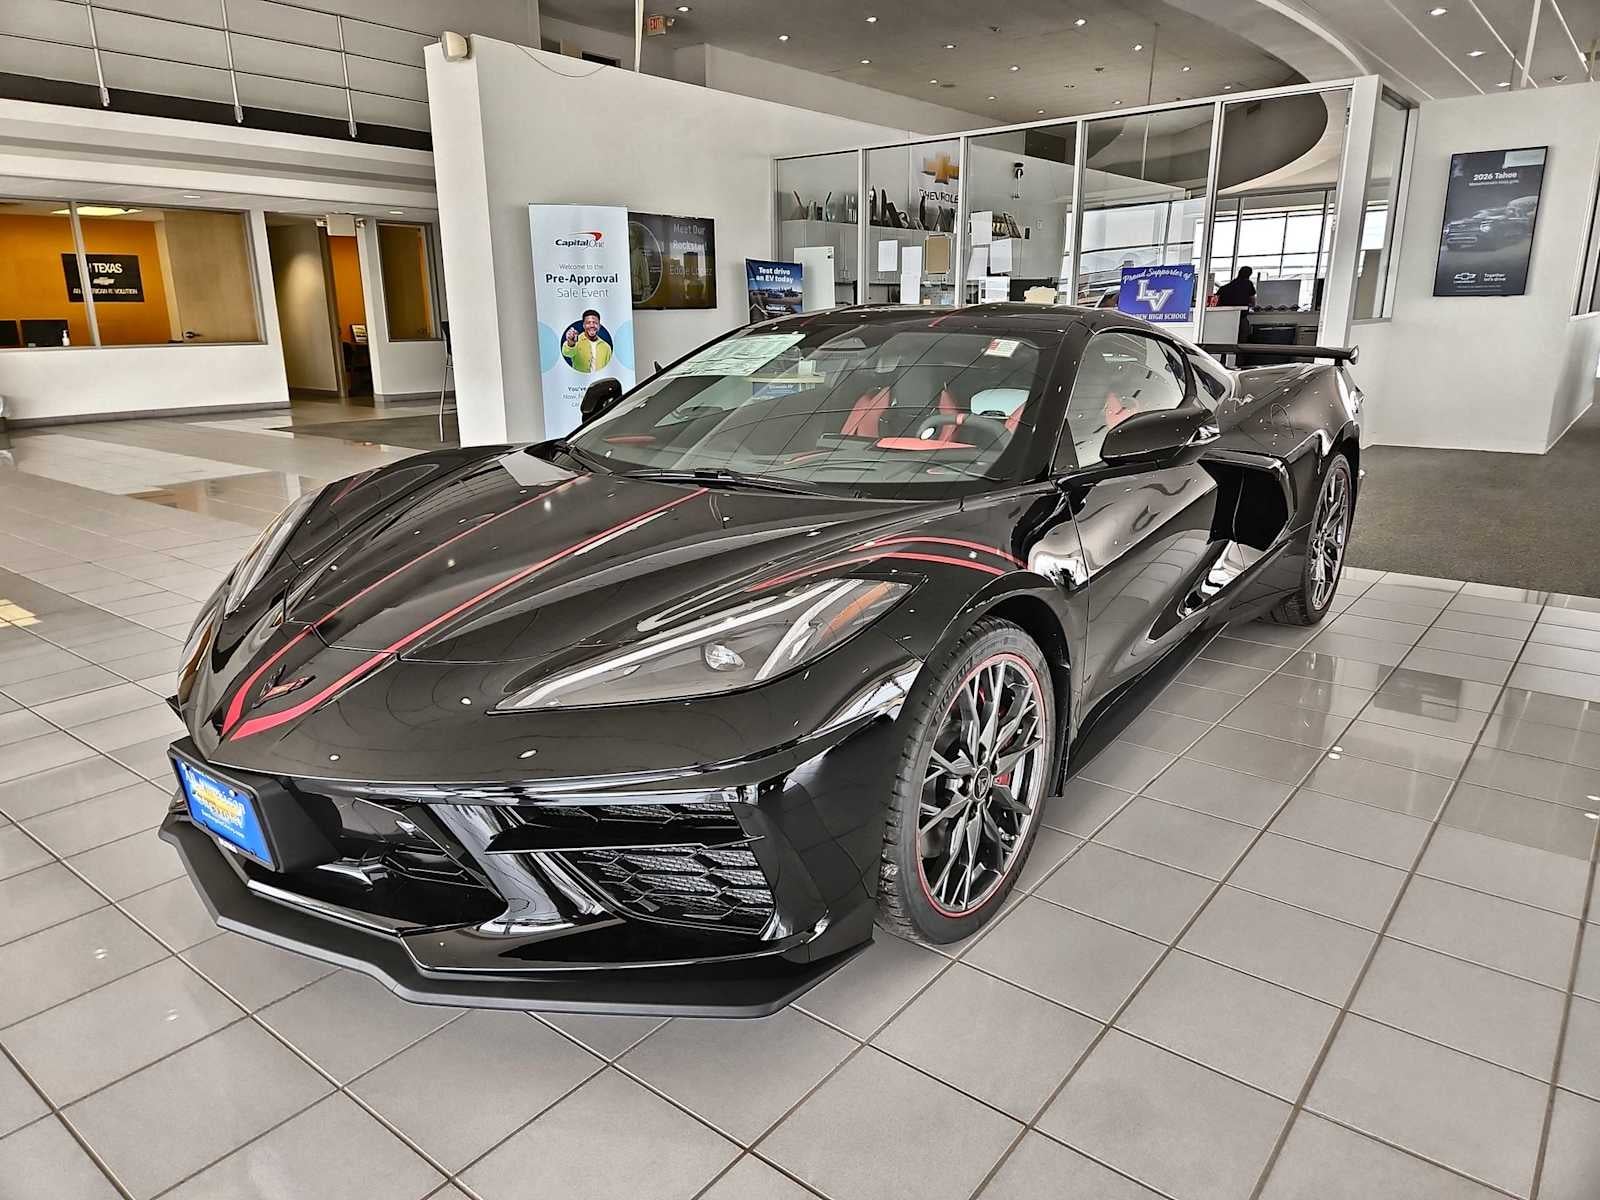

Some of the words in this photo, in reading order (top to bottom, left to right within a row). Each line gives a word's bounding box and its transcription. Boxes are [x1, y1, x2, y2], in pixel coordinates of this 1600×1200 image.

[1473, 173, 1494, 181] 2026
[1494, 172, 1518, 180] Tahoe
[92, 263, 122, 273] TEXAS
[759, 266, 774, 275] Test
[773, 267, 791, 275] drive
[545, 273, 619, 286] Pre-Approval
[775, 276, 794, 284] today
[1123, 269, 1147, 284] Proud
[1146, 268, 1183, 277] Supporter
[557, 287, 579, 298] Sale
[581, 287, 609, 298] Event
[1135, 279, 1175, 312] LV
[1164, 313, 1187, 321] SCHOOL
